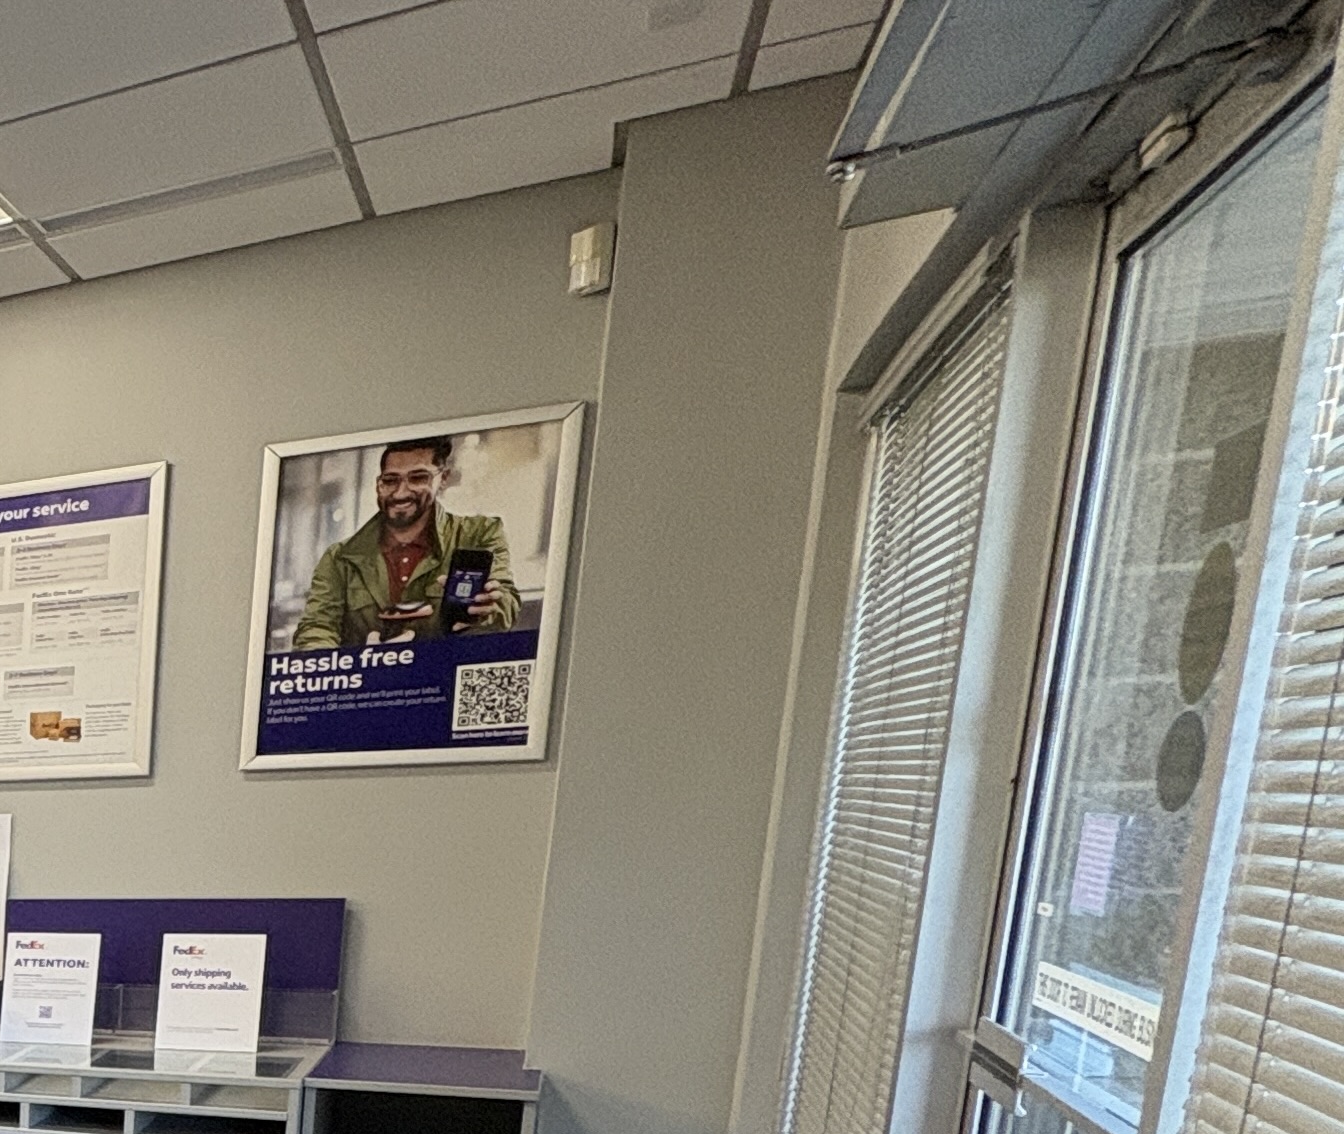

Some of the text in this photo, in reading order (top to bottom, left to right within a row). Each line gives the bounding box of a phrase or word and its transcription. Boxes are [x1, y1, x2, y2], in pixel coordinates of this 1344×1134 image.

[32, 498, 89, 517] service
[270, 648, 415, 676] Hassle free
[270, 672, 363, 695] returns
[16, 940, 44, 950] FedEx
[173, 946, 207, 955] FedEx
[14, 958, 90, 968] ATTENTION:
[172, 968, 231, 979] Only shipping
[171, 981, 249, 991] services available.
